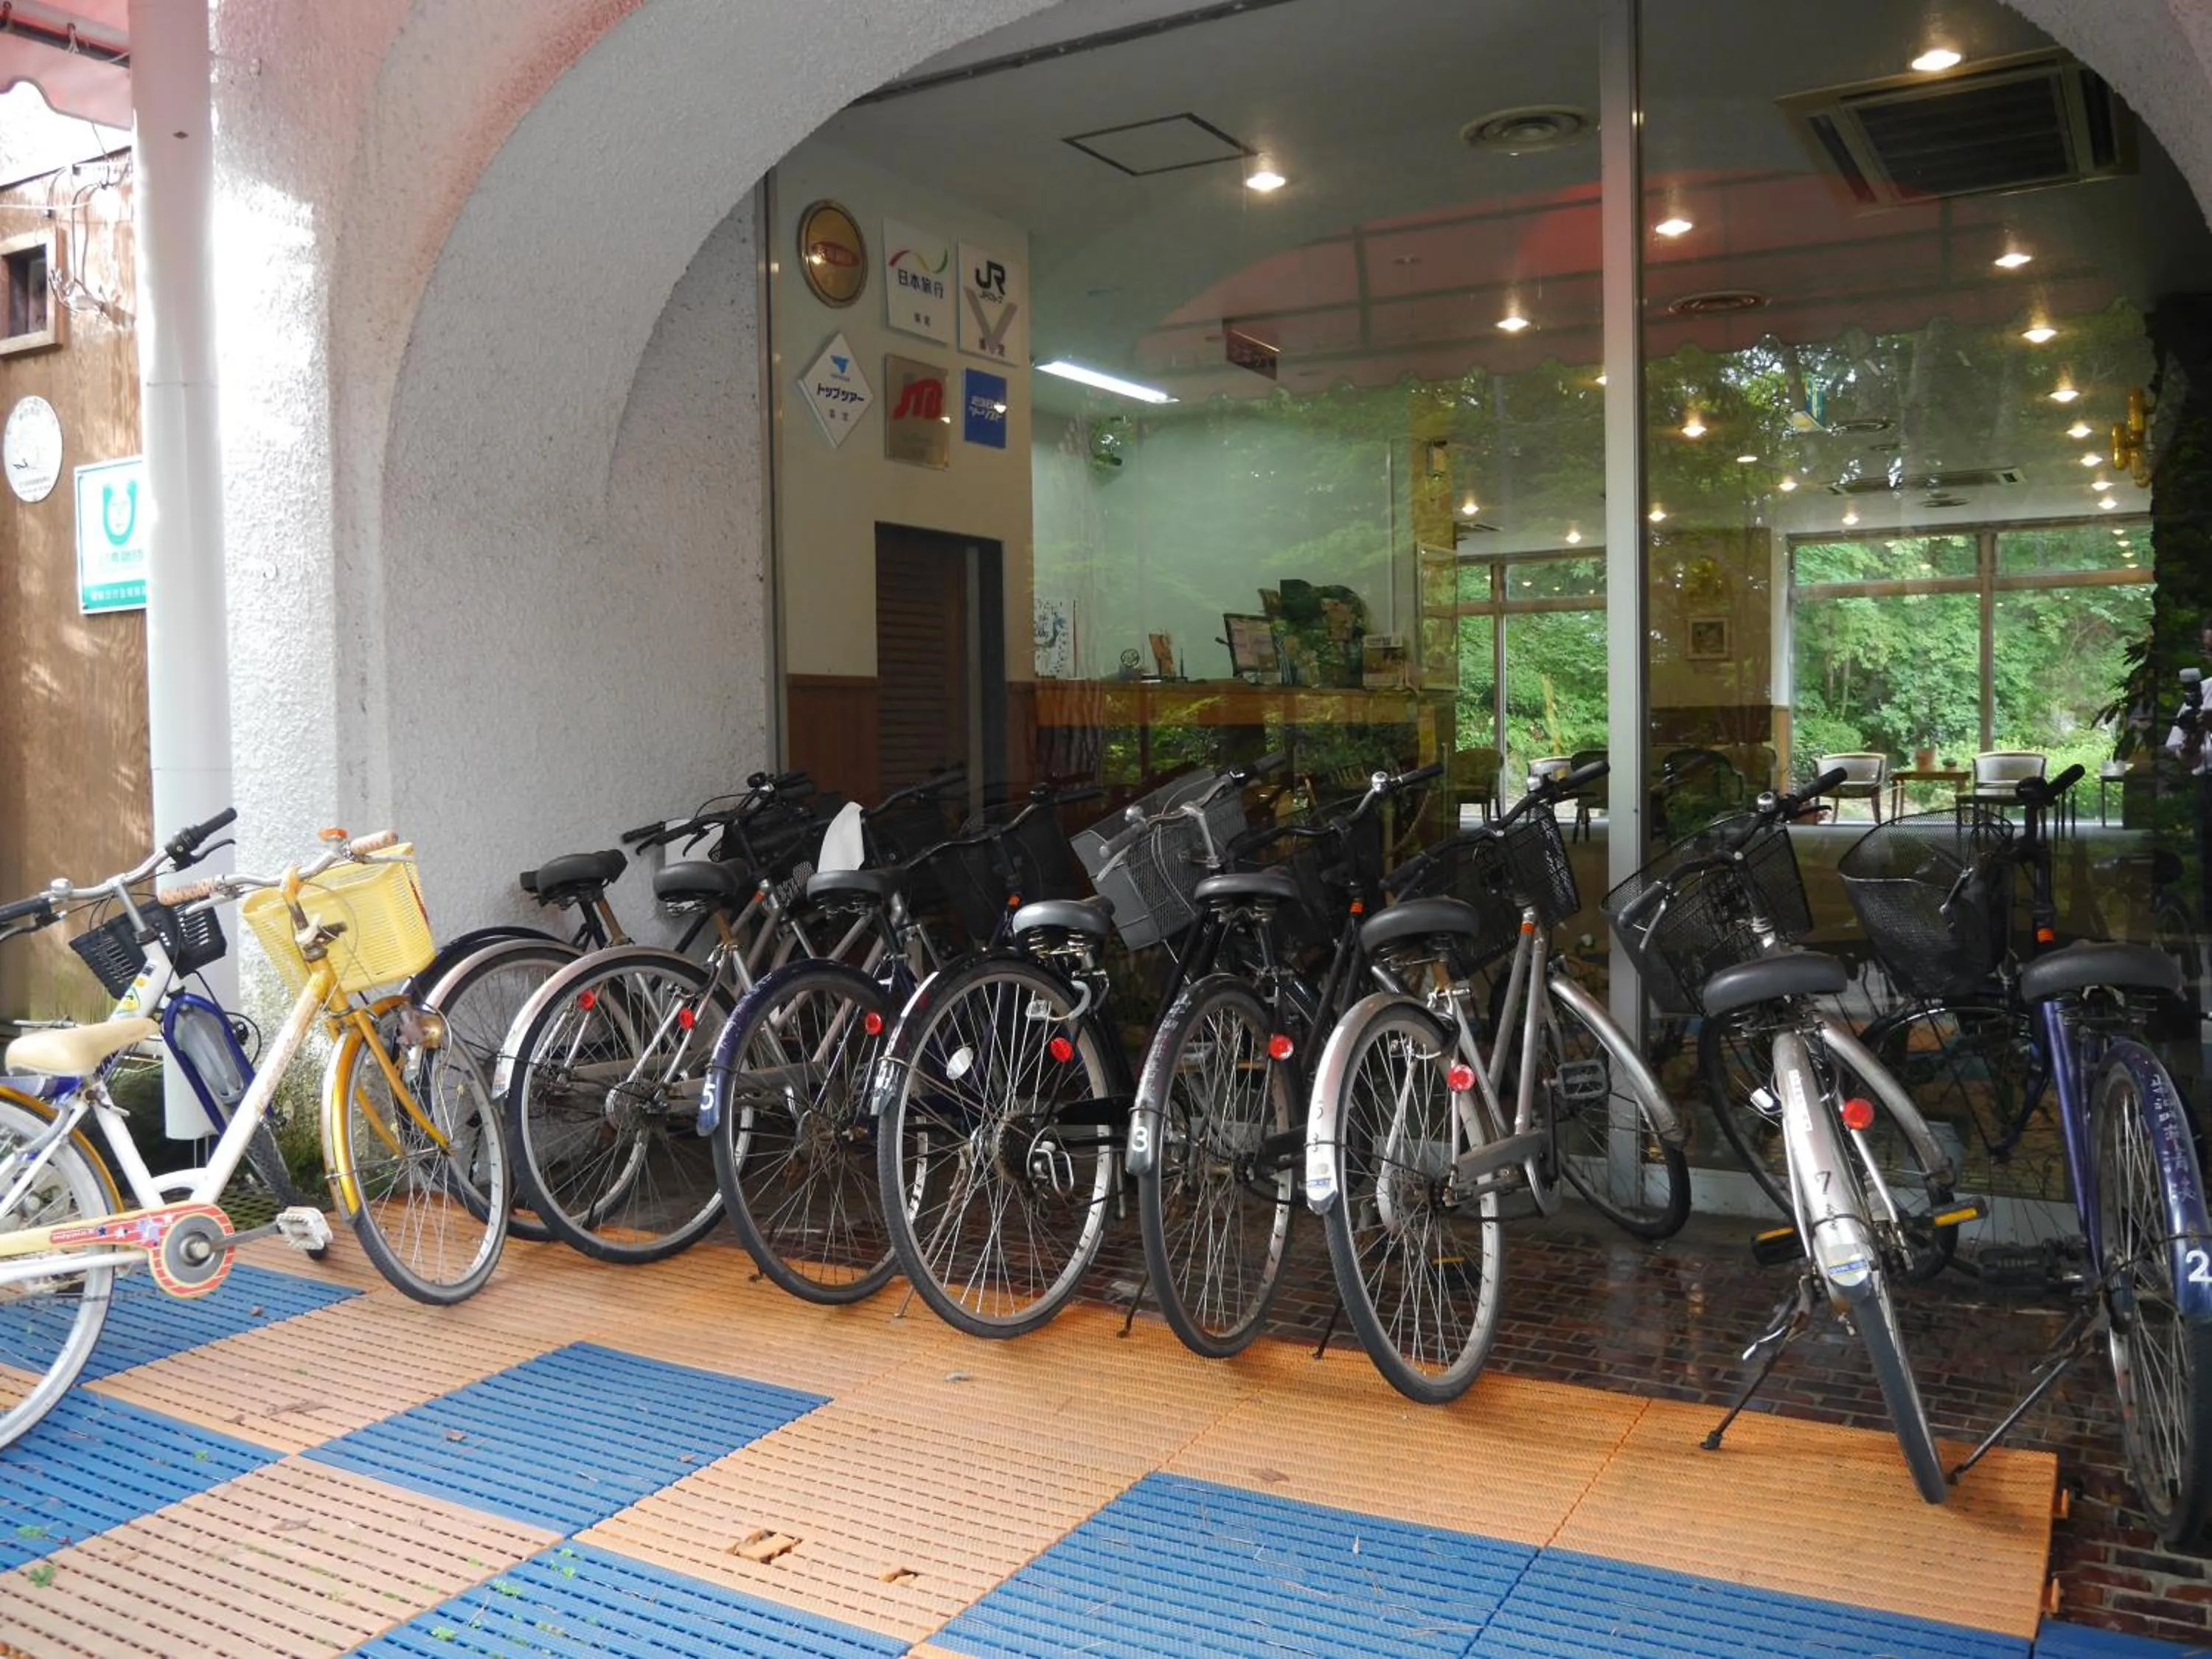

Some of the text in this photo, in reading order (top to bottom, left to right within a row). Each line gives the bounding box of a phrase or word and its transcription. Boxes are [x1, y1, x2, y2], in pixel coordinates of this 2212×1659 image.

[897, 268, 944, 299] 日本旅行
[975, 260, 1006, 295] JR
[700, 1082, 716, 1110] 5
[1131, 1126, 1149, 1152] 3
[1815, 1170, 1832, 1195] 7
[2185, 1249, 2212, 1283] 2
